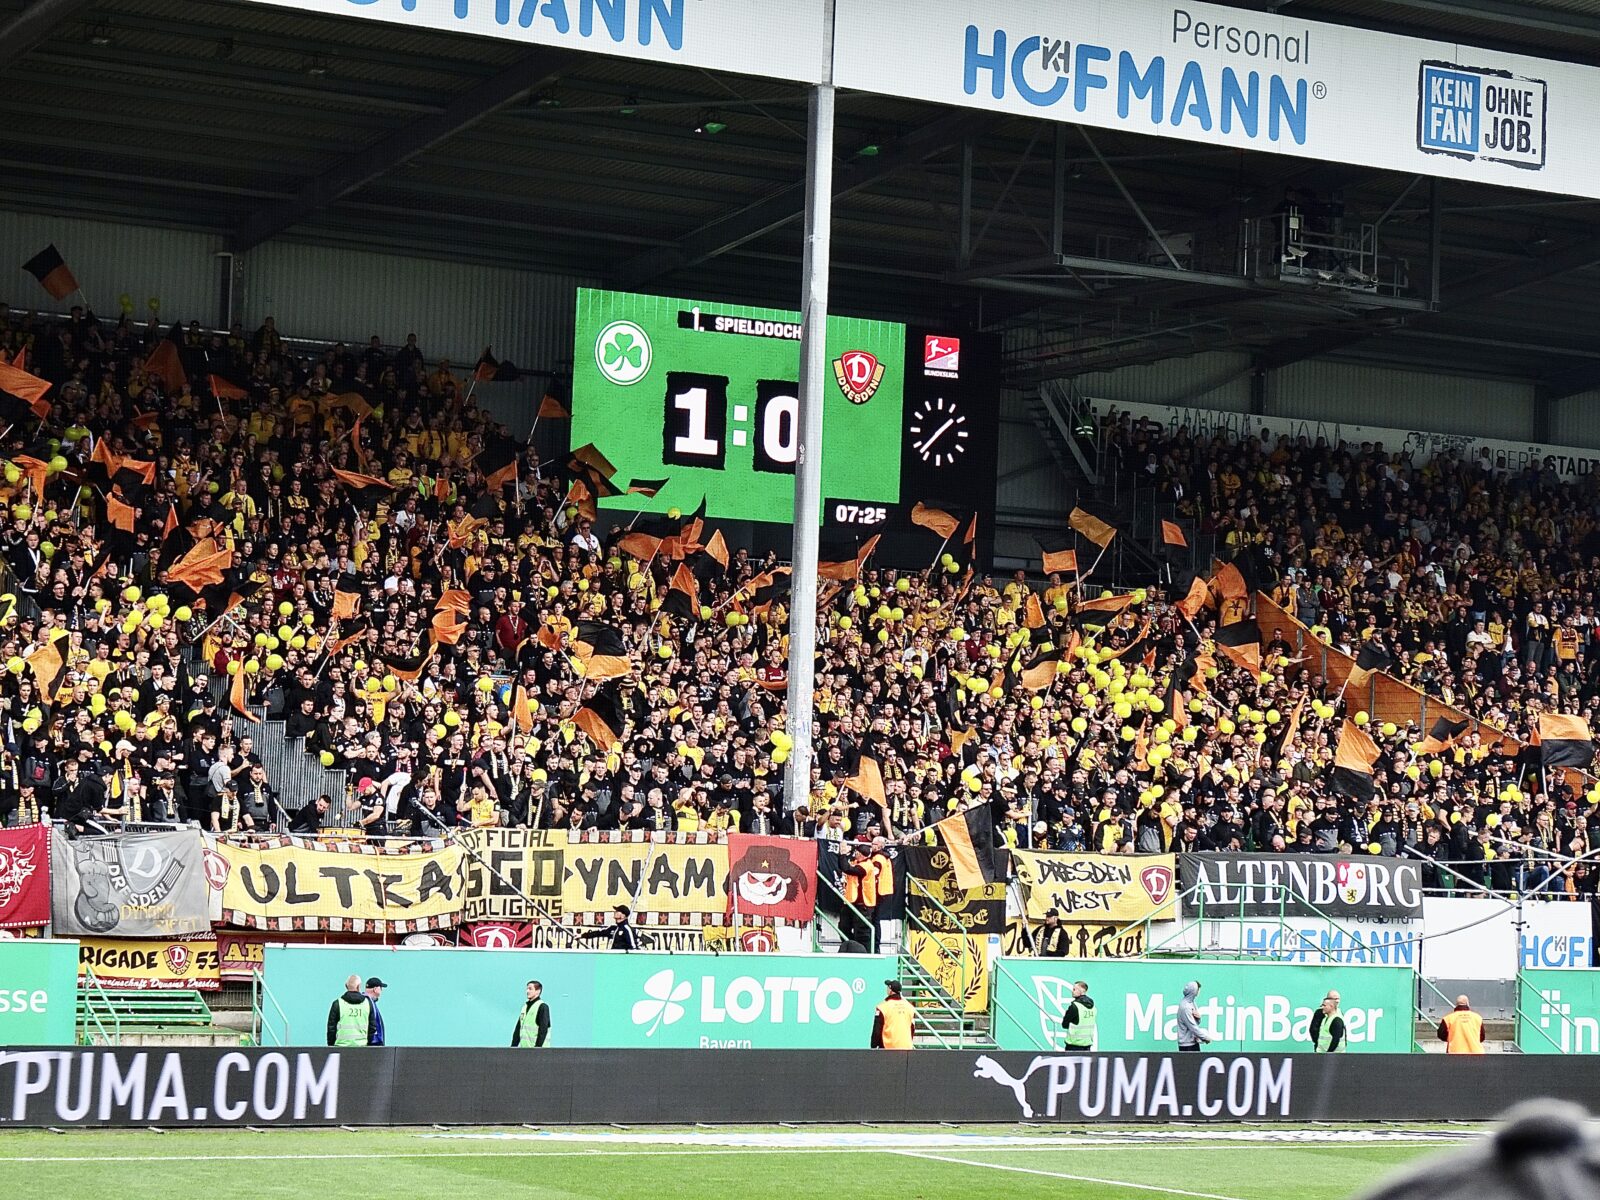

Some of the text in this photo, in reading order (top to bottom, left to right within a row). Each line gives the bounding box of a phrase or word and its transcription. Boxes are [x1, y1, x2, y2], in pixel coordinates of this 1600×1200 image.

[1172, 9, 1310, 64] Personal
[964, 24, 1308, 146] HOFMANN
[1431, 76, 1474, 110] KEIN
[1485, 86, 1533, 117] OHNE
[1429, 107, 1472, 146] FAN
[1485, 117, 1538, 155] JOB.
[692, 307, 801, 340] 1. SPIELDOOCH
[838, 374, 881, 404] DRESDEN
[836, 505, 887, 524] 07:25
[462, 829, 554, 850] OFFICIAL
[107, 865, 168, 907] DRESDEN
[564, 853, 729, 901] YNAM
[1035, 859, 1131, 885] DRESDEN
[1052, 890, 1121, 913] WEST
[1093, 926, 1143, 957] Riot
[1520, 934, 1593, 967] HOF
[195, 951, 219, 970] 53
[348, 1007, 362, 1018] 231
[701, 976, 854, 1024] LOTTO
[1083, 1010, 1095, 1019] 234
[1127, 992, 1384, 1043] MatinBaer
[700, 1036, 752, 1049] Bayern
[12, 1052, 341, 1121] PUMA.COM
[1044, 1056, 1293, 1118] PUMA.COM
